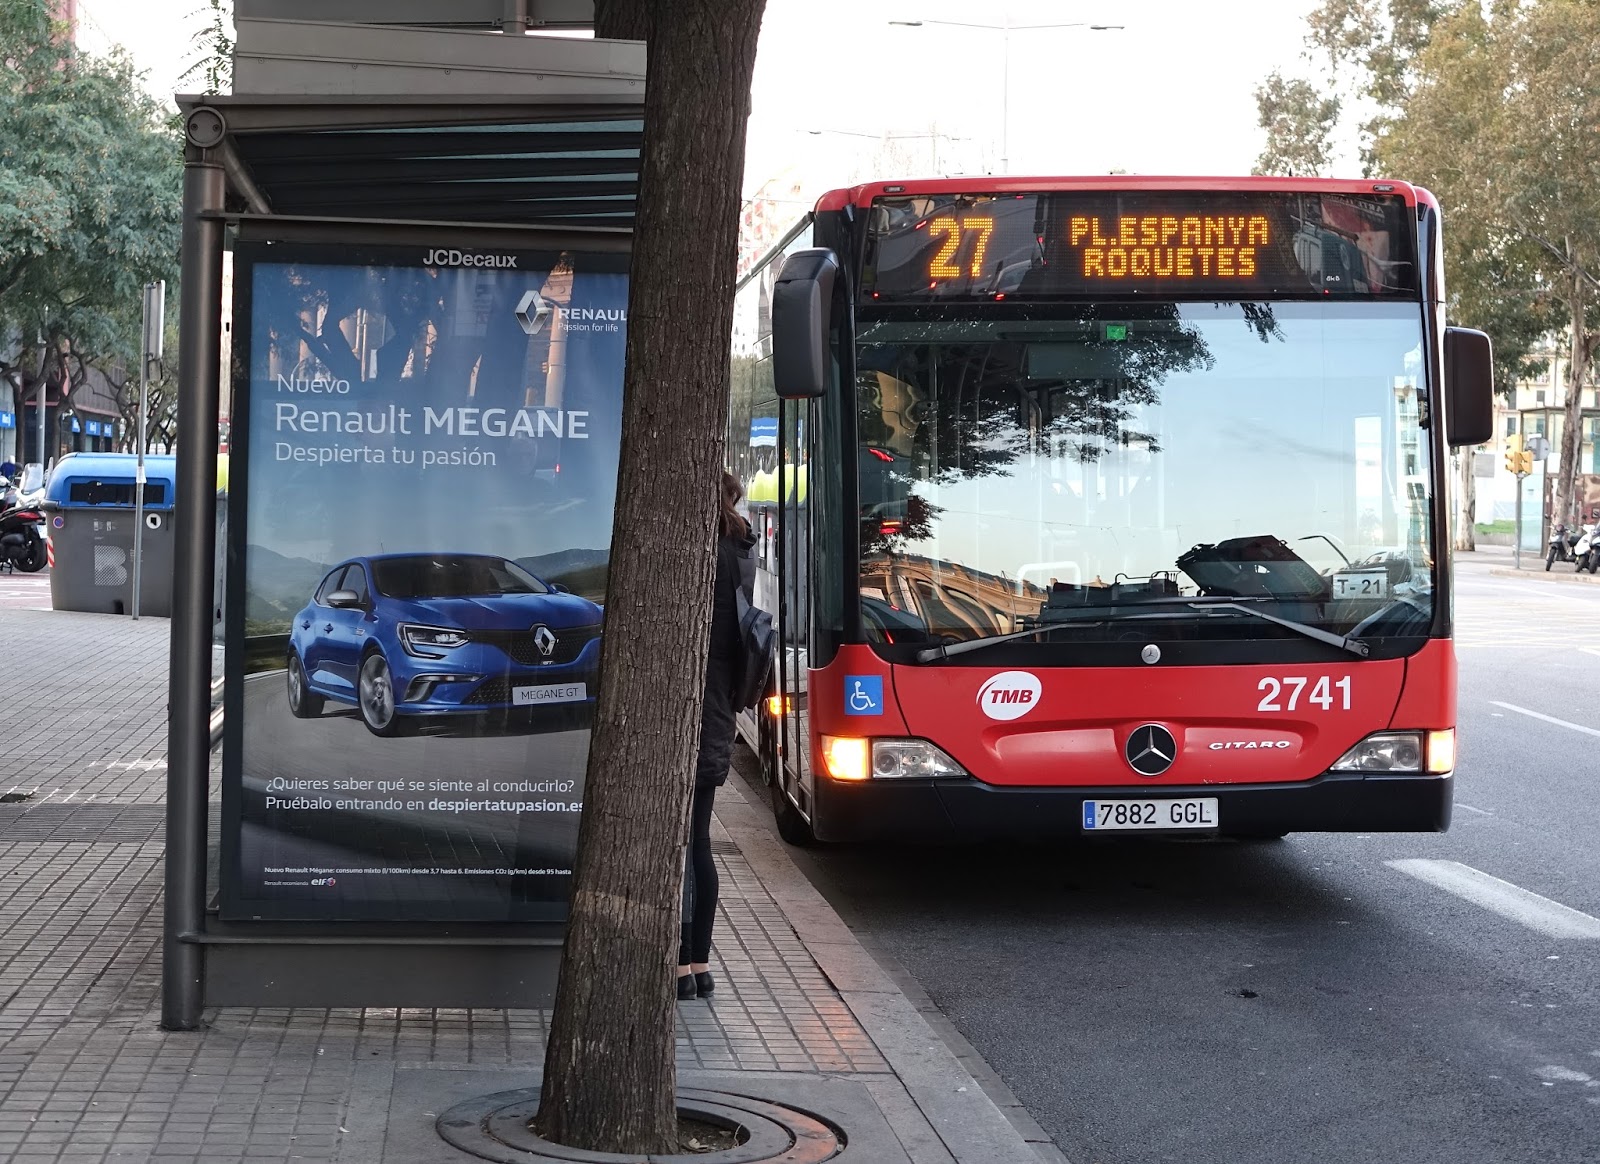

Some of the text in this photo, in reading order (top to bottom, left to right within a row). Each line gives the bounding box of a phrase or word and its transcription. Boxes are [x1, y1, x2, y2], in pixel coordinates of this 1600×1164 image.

[1070, 216, 1268, 246] PL.ESPANYA
[929, 217, 994, 278] 27
[422, 249, 517, 268] JCDecaux
[1084, 247, 1256, 277] ROQUETES
[558, 308, 628, 321] RENAUL
[557, 322, 619, 332] Passion for life
[277, 373, 350, 394] Nuevo
[275, 403, 589, 439] Renault MEGANE
[275, 442, 497, 469] Despierta tu pasión
[1361, 579, 1381, 594] 21
[521, 687, 579, 700] MEGANE GT
[991, 689, 1033, 704] TMB
[1257, 675, 1351, 711] 2741
[1208, 740, 1291, 750] CITARO
[266, 776, 575, 793] ¿Quieres saber qué se siente al conducirlo?
[266, 796, 332, 811] Pruébalo
[335, 797, 403, 811] entrando
[406, 800, 424, 811] en
[1100, 803, 1157, 826] 7882
[1170, 802, 1212, 824] GGL
